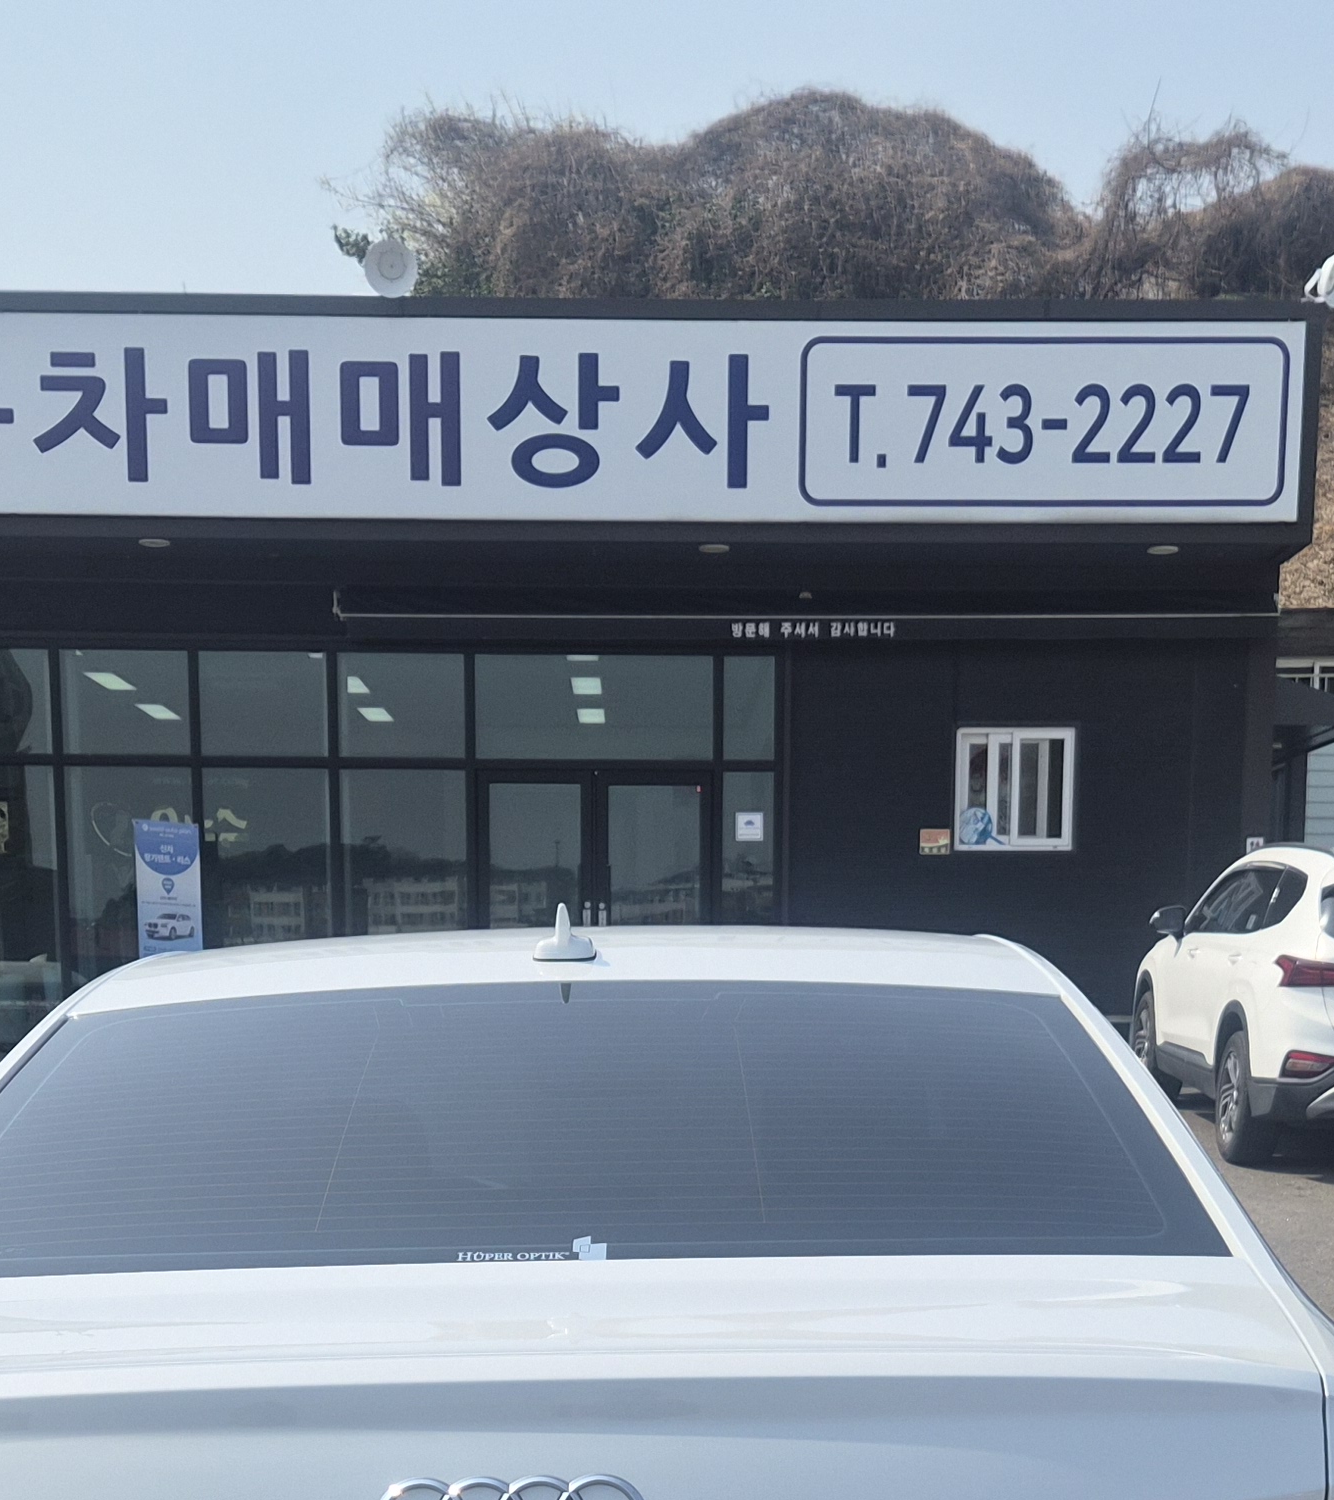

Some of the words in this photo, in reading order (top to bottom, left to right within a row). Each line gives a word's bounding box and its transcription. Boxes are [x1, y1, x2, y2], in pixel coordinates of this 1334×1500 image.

[731, 621, 770, 638] 방문해
[780, 621, 819, 638] 주셔서
[830, 621, 896, 638] 감사합니다
